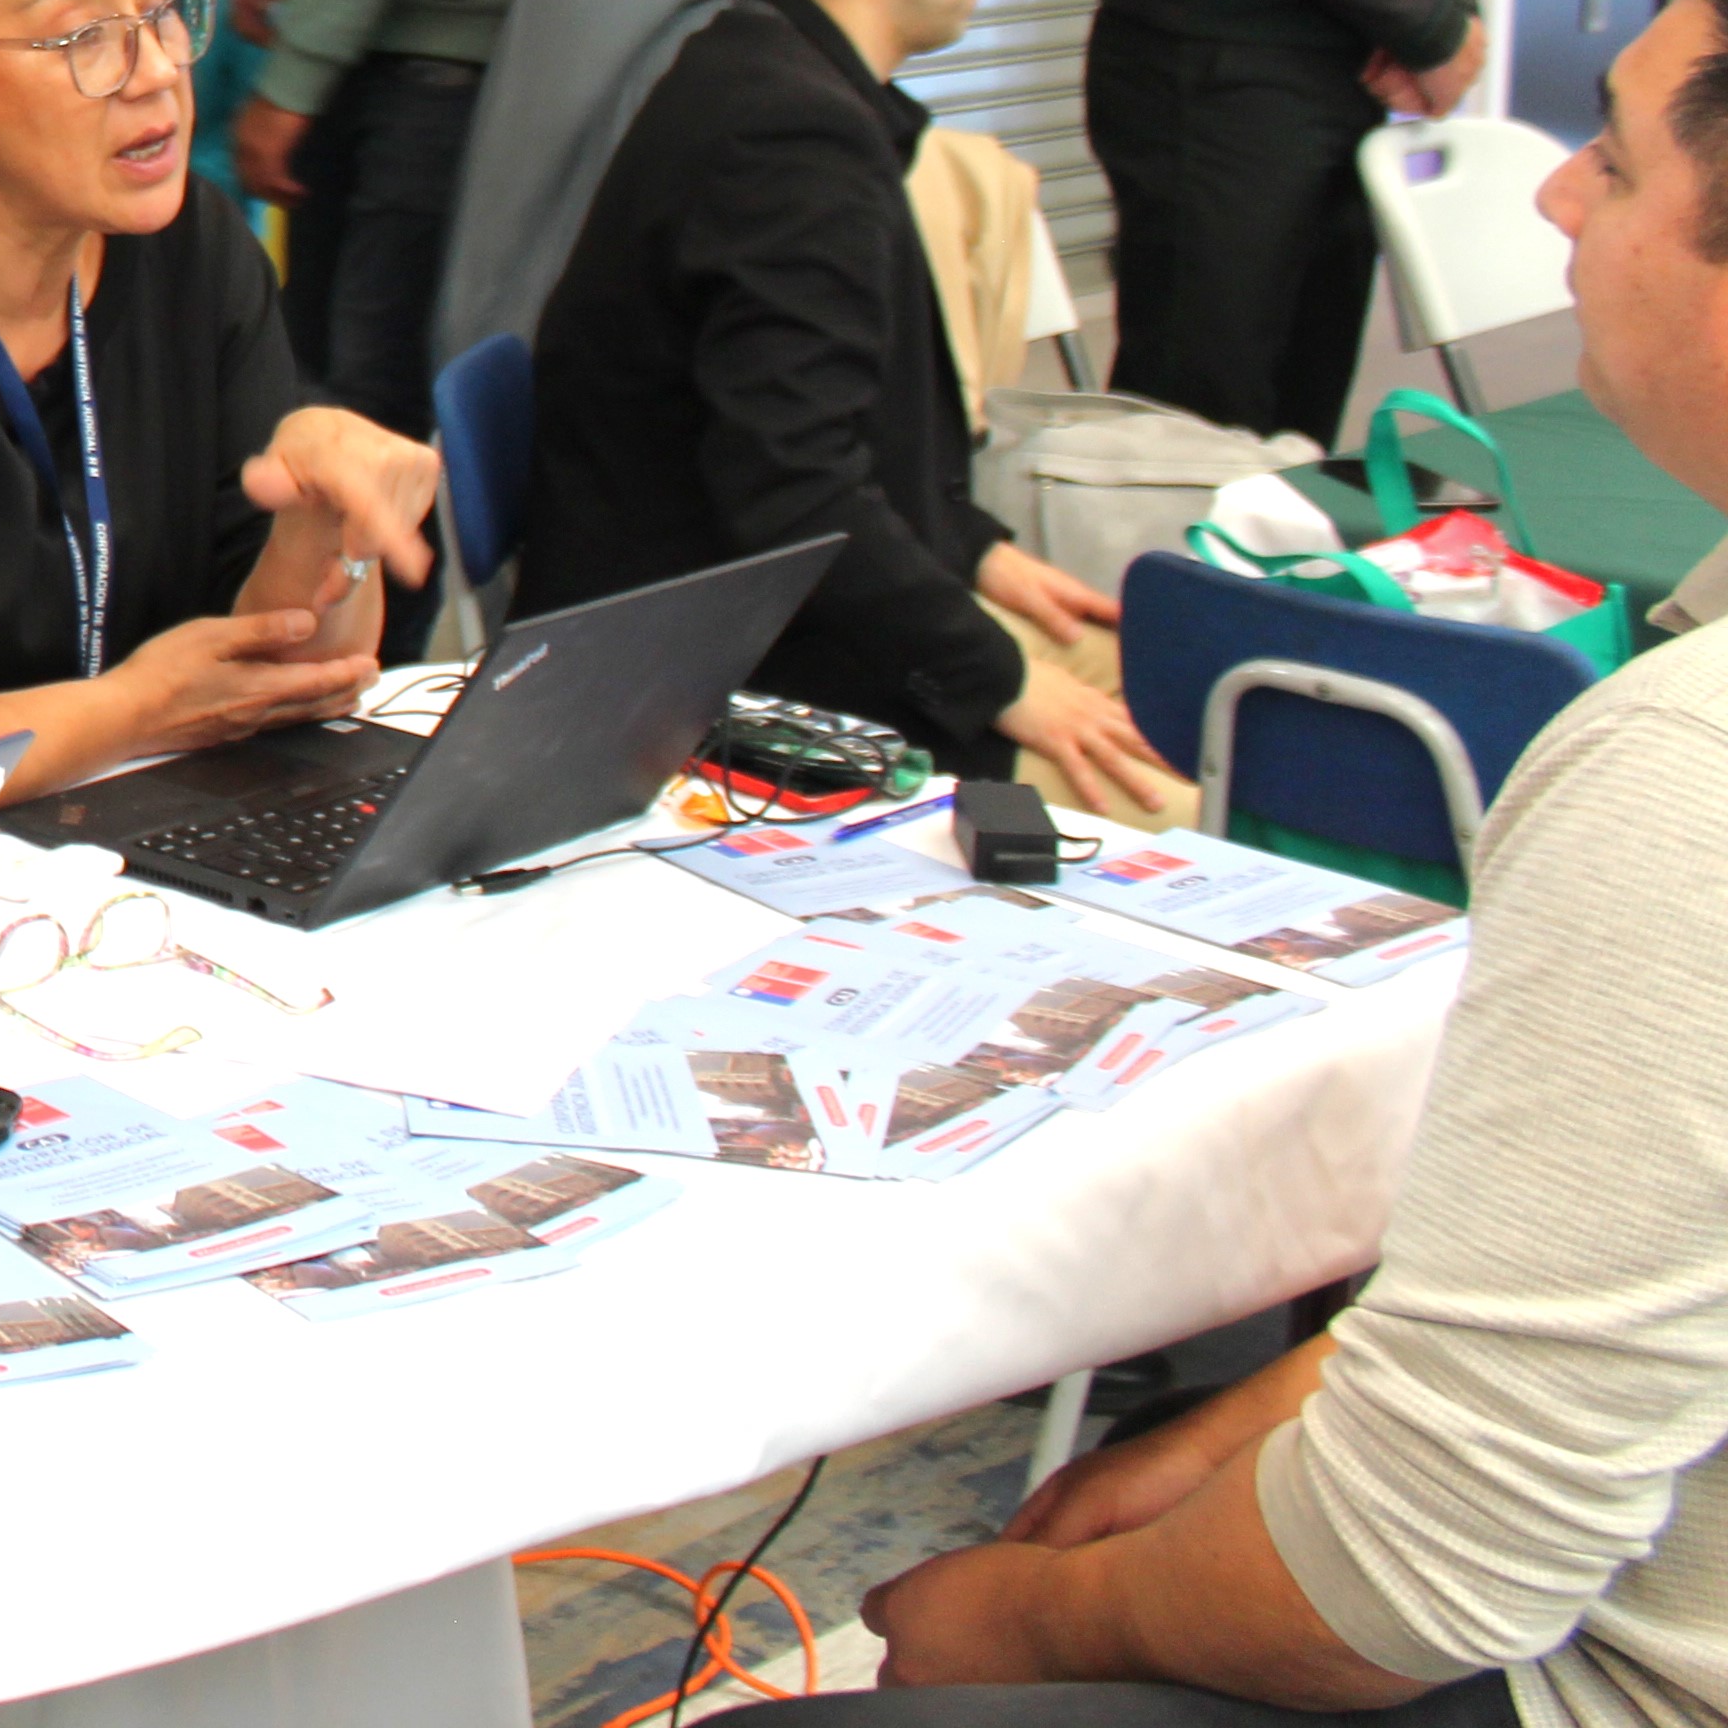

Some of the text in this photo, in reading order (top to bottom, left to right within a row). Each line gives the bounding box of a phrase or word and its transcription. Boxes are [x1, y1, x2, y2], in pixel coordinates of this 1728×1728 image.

[75, 335, 92, 402] ASISTENCIA
[83, 402, 98, 453] JUDICIAL
[95, 522, 109, 609] CORPORACION
[94, 610, 105, 627] DE
